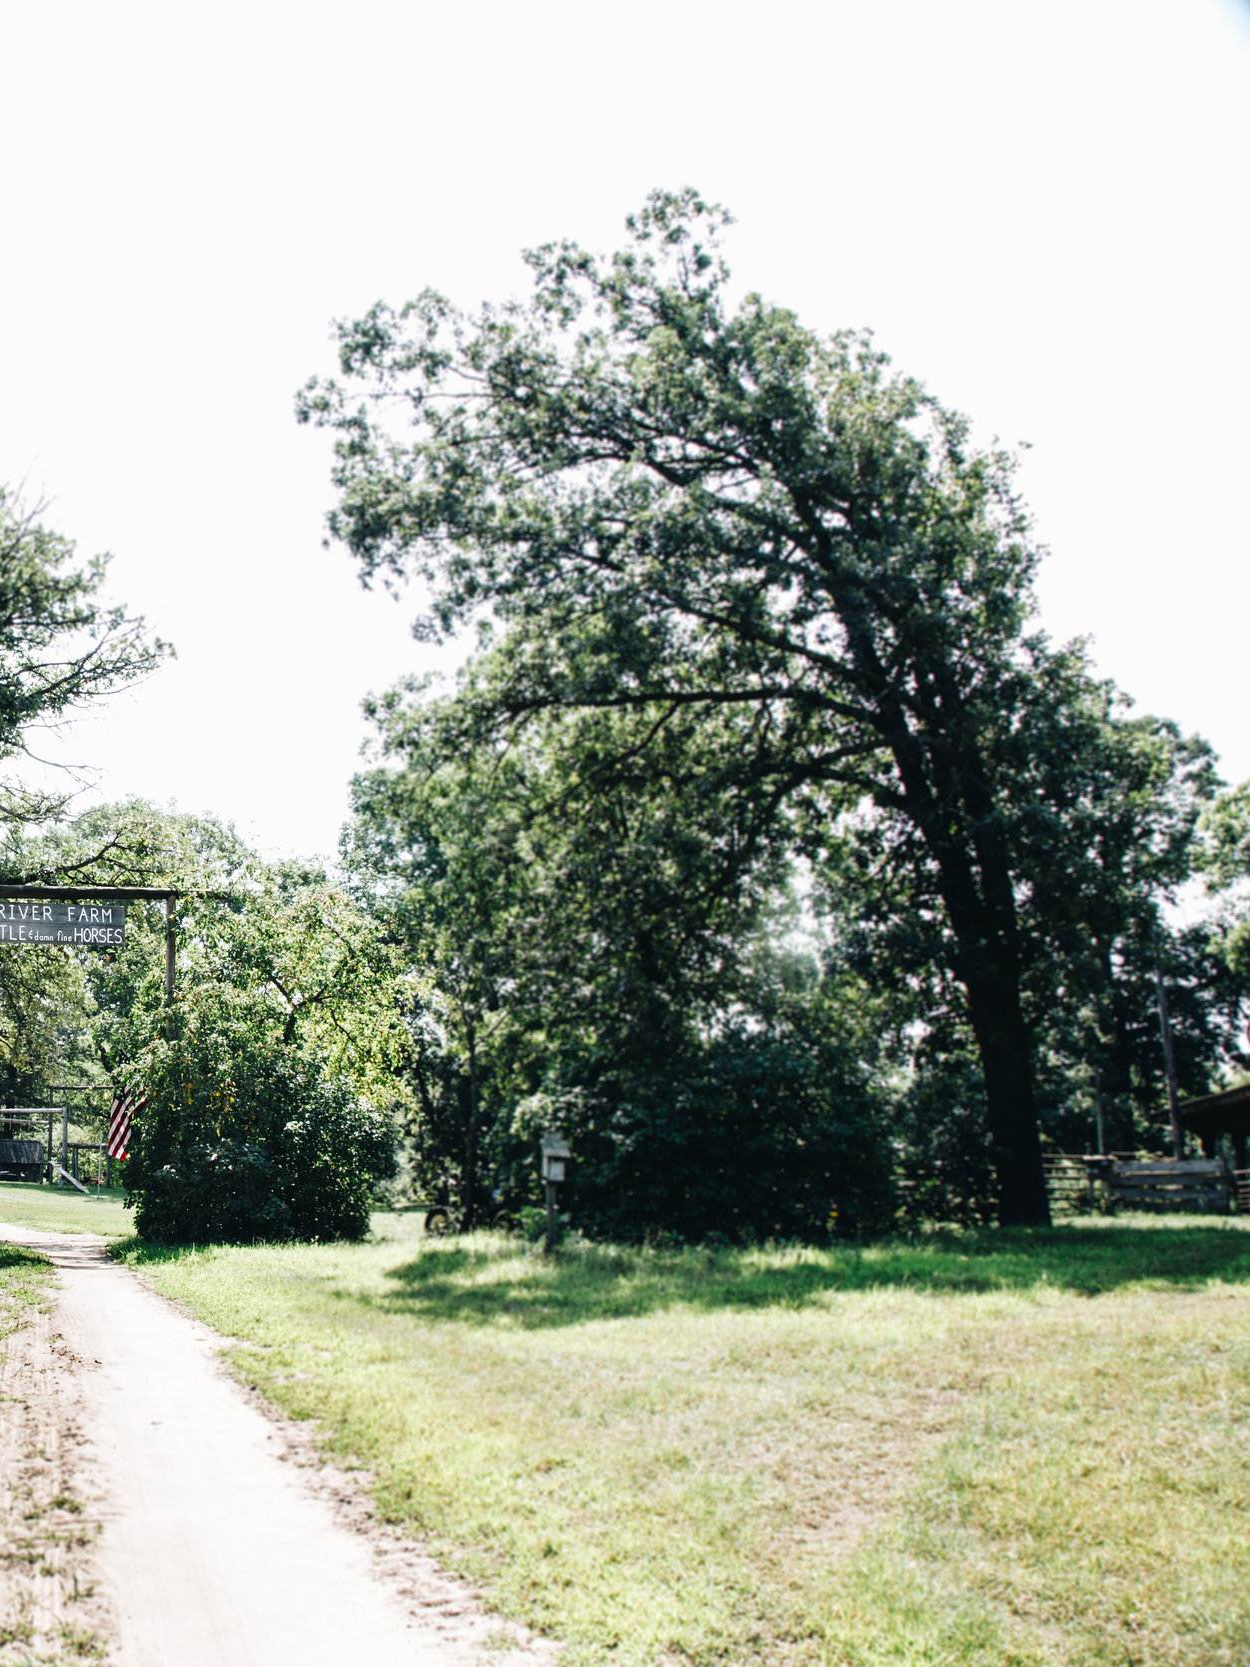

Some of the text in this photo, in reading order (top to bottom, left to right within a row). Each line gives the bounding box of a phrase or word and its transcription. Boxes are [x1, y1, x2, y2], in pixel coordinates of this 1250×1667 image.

[67, 906, 113, 923] FARM
[34, 930, 54, 941] damn
[57, 930, 72, 942] fine
[74, 927, 123, 944] HORSES
